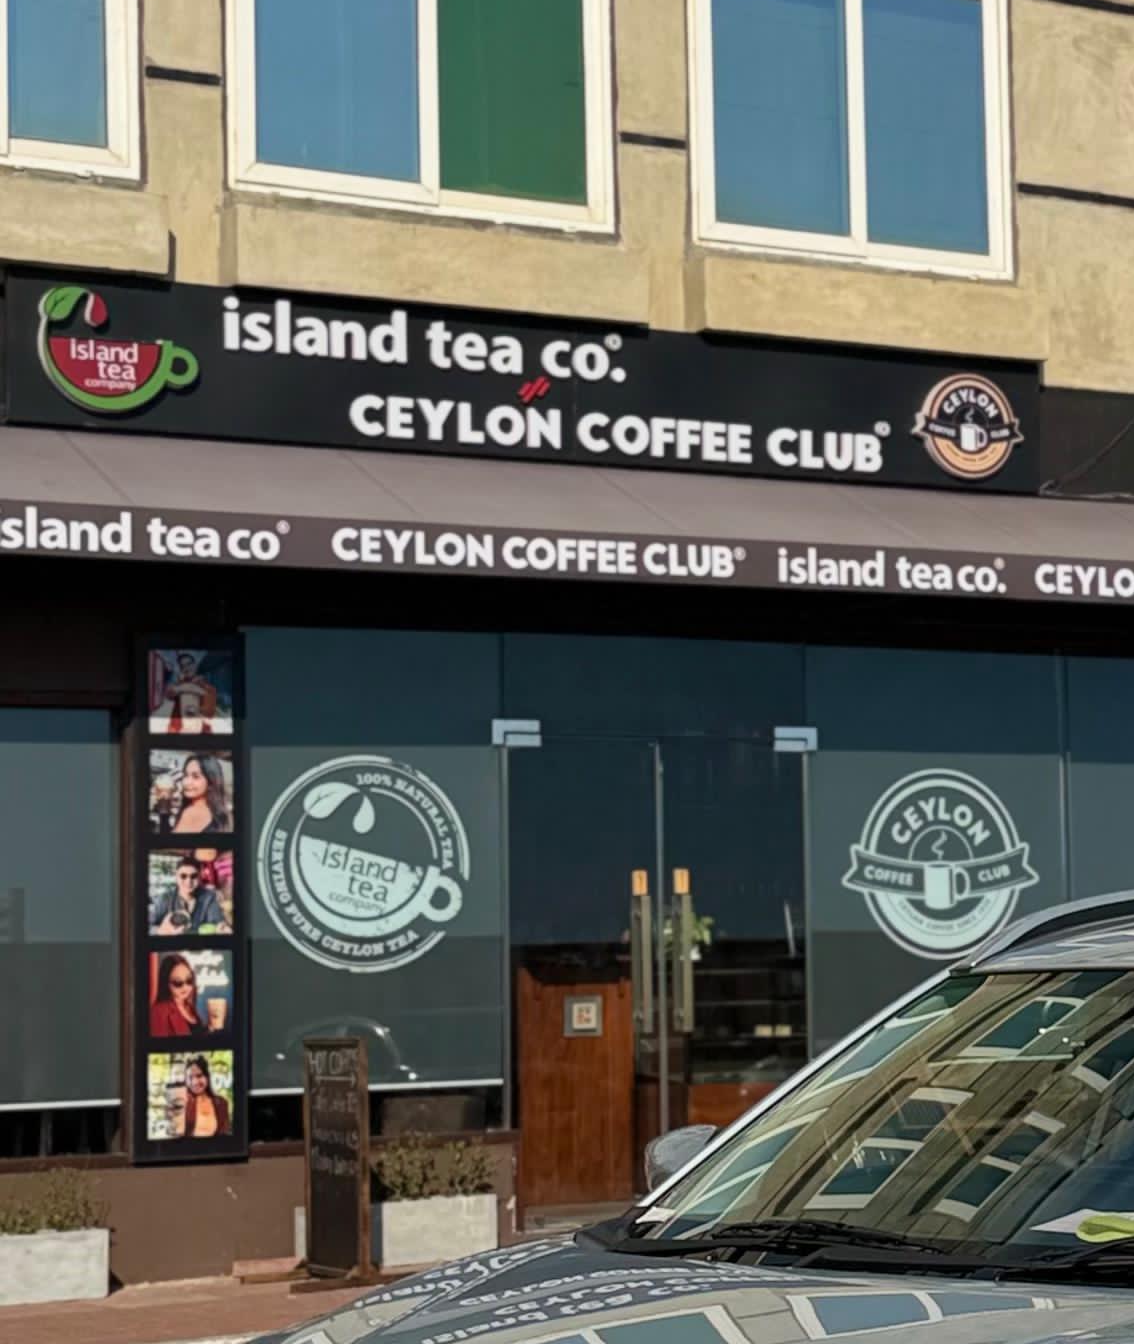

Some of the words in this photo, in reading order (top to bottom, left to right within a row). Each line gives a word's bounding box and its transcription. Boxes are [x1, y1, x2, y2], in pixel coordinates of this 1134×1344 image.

[223, 296, 408, 364] island
[426, 321, 524, 375] tea
[97, 361, 137, 381] tea
[943, 389, 999, 418] CEYLON
[349, 394, 562, 449] CEYLON
[576, 412, 753, 463] COFFEE
[0, 506, 132, 553] sland
[146, 517, 221, 558] tea
[331, 527, 494, 567] CEYLON
[502, 536, 637, 574] COFFEE
[778, 546, 885, 587] island
[896, 556, 953, 590] tea
[356, 773, 393, 787] 100%
[393, 778, 449, 837] NATURAL
[441, 837, 454, 870] TEA
[891, 797, 991, 846] CEYLON
[271, 828, 292, 904] SERVING
[285, 902, 322, 943] PURE
[321, 935, 385, 956] CEYLON
[385, 929, 419, 952] TEA
[348, 875, 388, 903] tea
[863, 864, 914, 886] COFFEE
[977, 864, 1011, 883] CLUB
